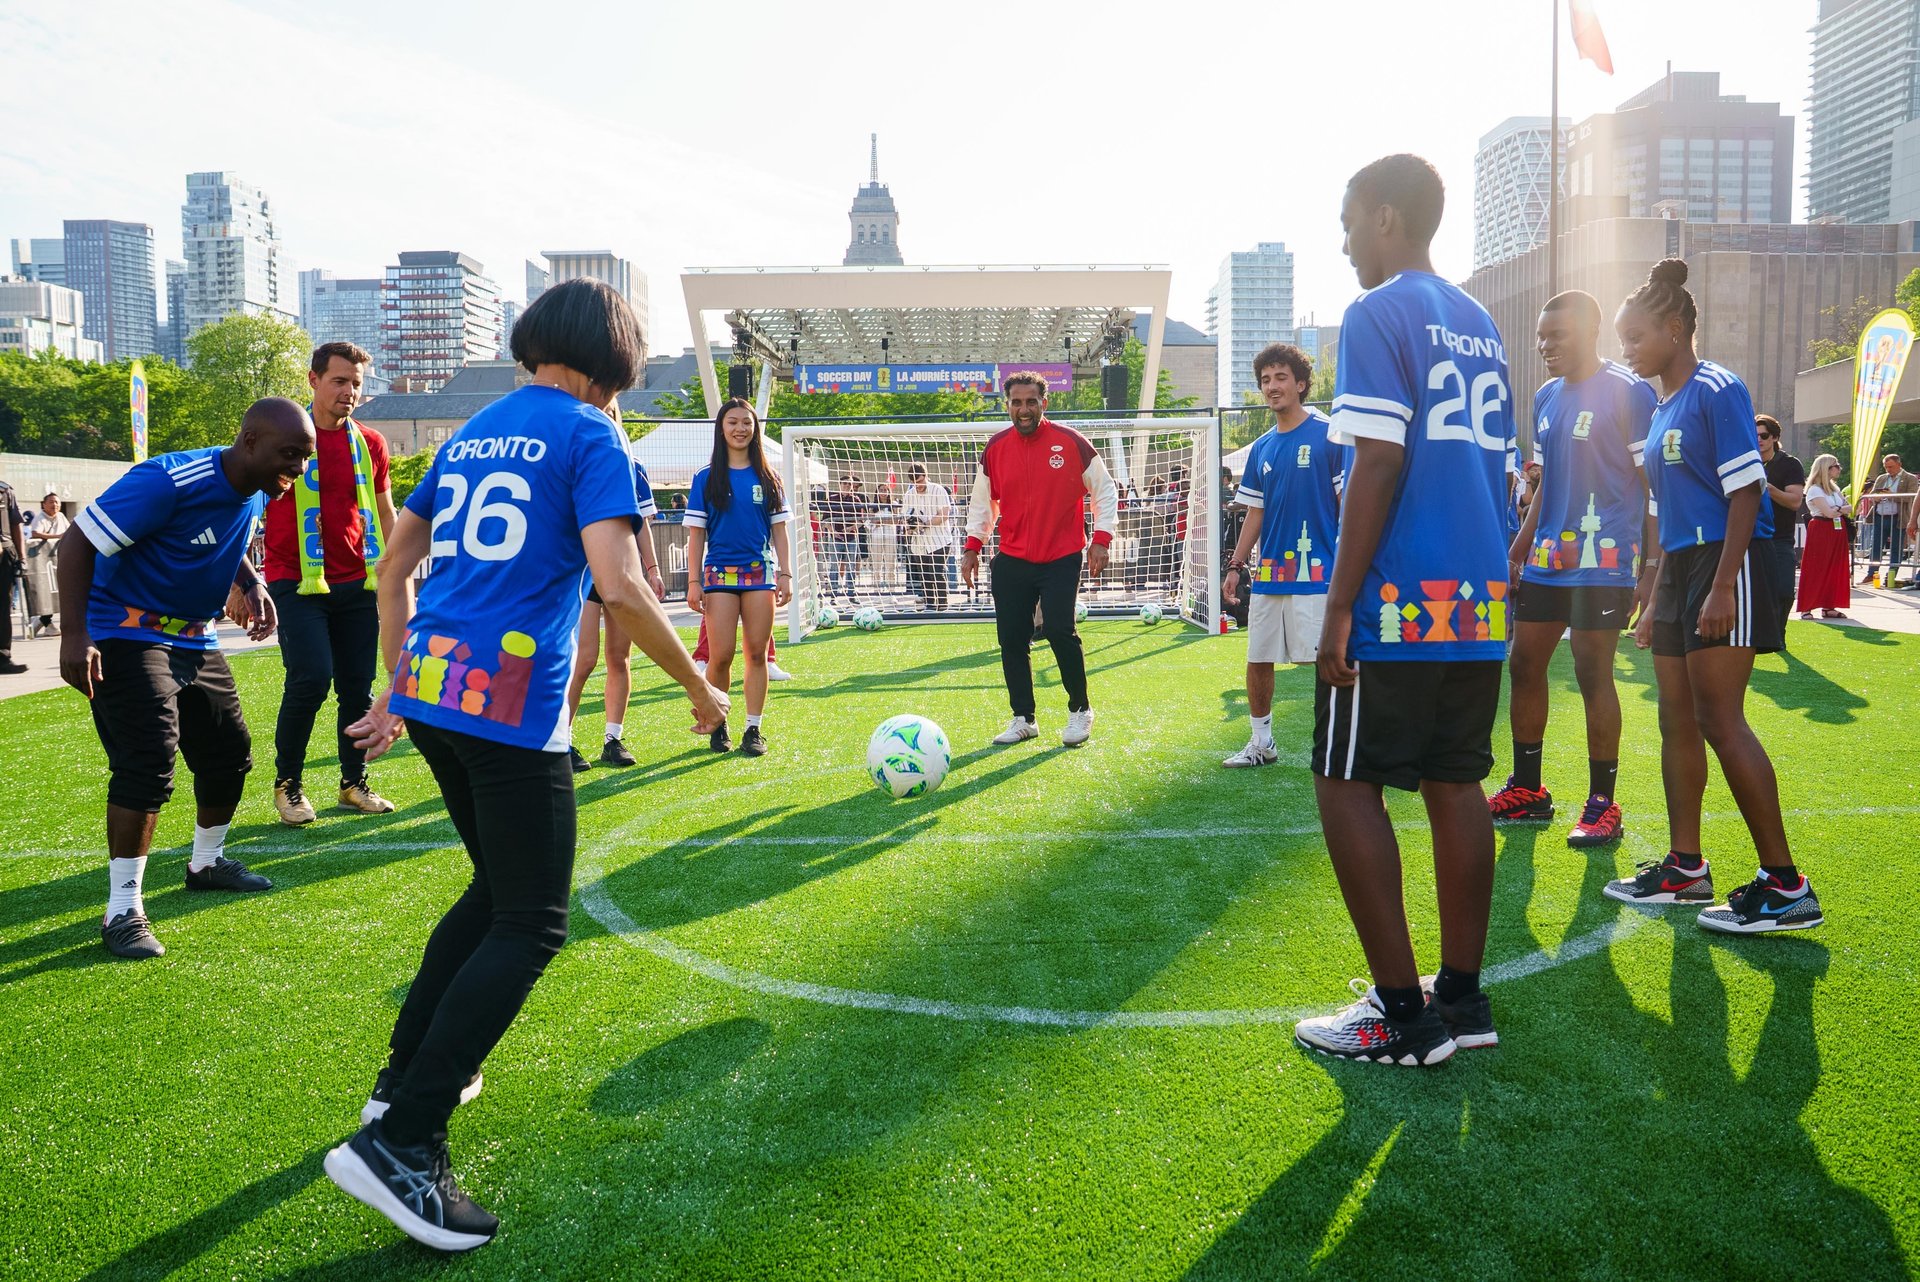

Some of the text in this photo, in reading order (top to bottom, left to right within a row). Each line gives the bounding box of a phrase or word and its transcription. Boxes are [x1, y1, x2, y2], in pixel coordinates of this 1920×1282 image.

[817, 371, 872, 383] SOCCER DAY
[896, 369, 987, 382] LA JOURNÉE SOCCER
[1427, 360, 1508, 452] 26
[447, 436, 547, 463] ORONTO
[430, 471, 532, 561] 26
